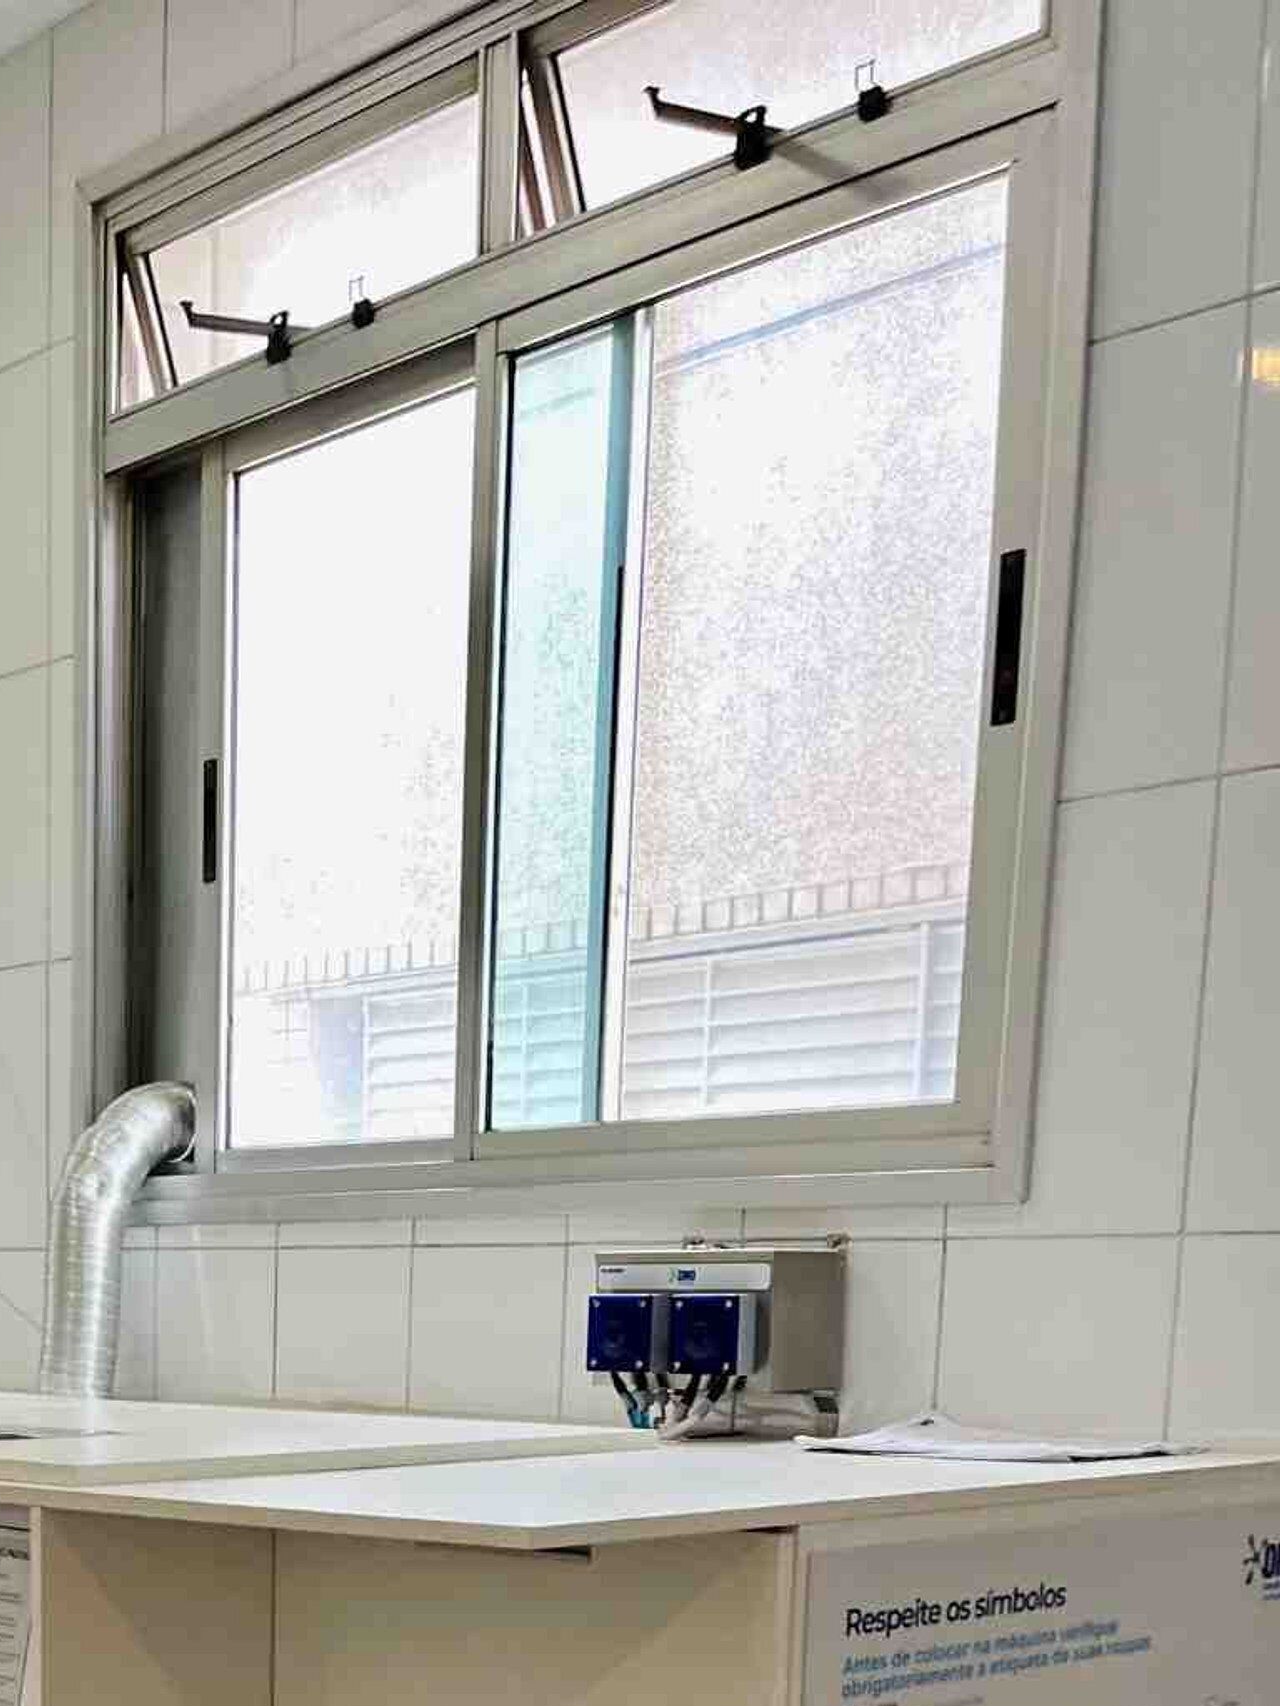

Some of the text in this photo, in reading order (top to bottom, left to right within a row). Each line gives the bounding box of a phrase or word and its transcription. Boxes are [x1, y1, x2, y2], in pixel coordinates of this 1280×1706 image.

[845, 1582, 1067, 1638] Respeite os símbolos
[842, 1652, 888, 1675] Antes
[890, 1648, 910, 1668] de
[914, 1641, 971, 1664] colocar
[972, 1638, 990, 1655] na
[840, 1661, 974, 1698] obrigatoriamente
